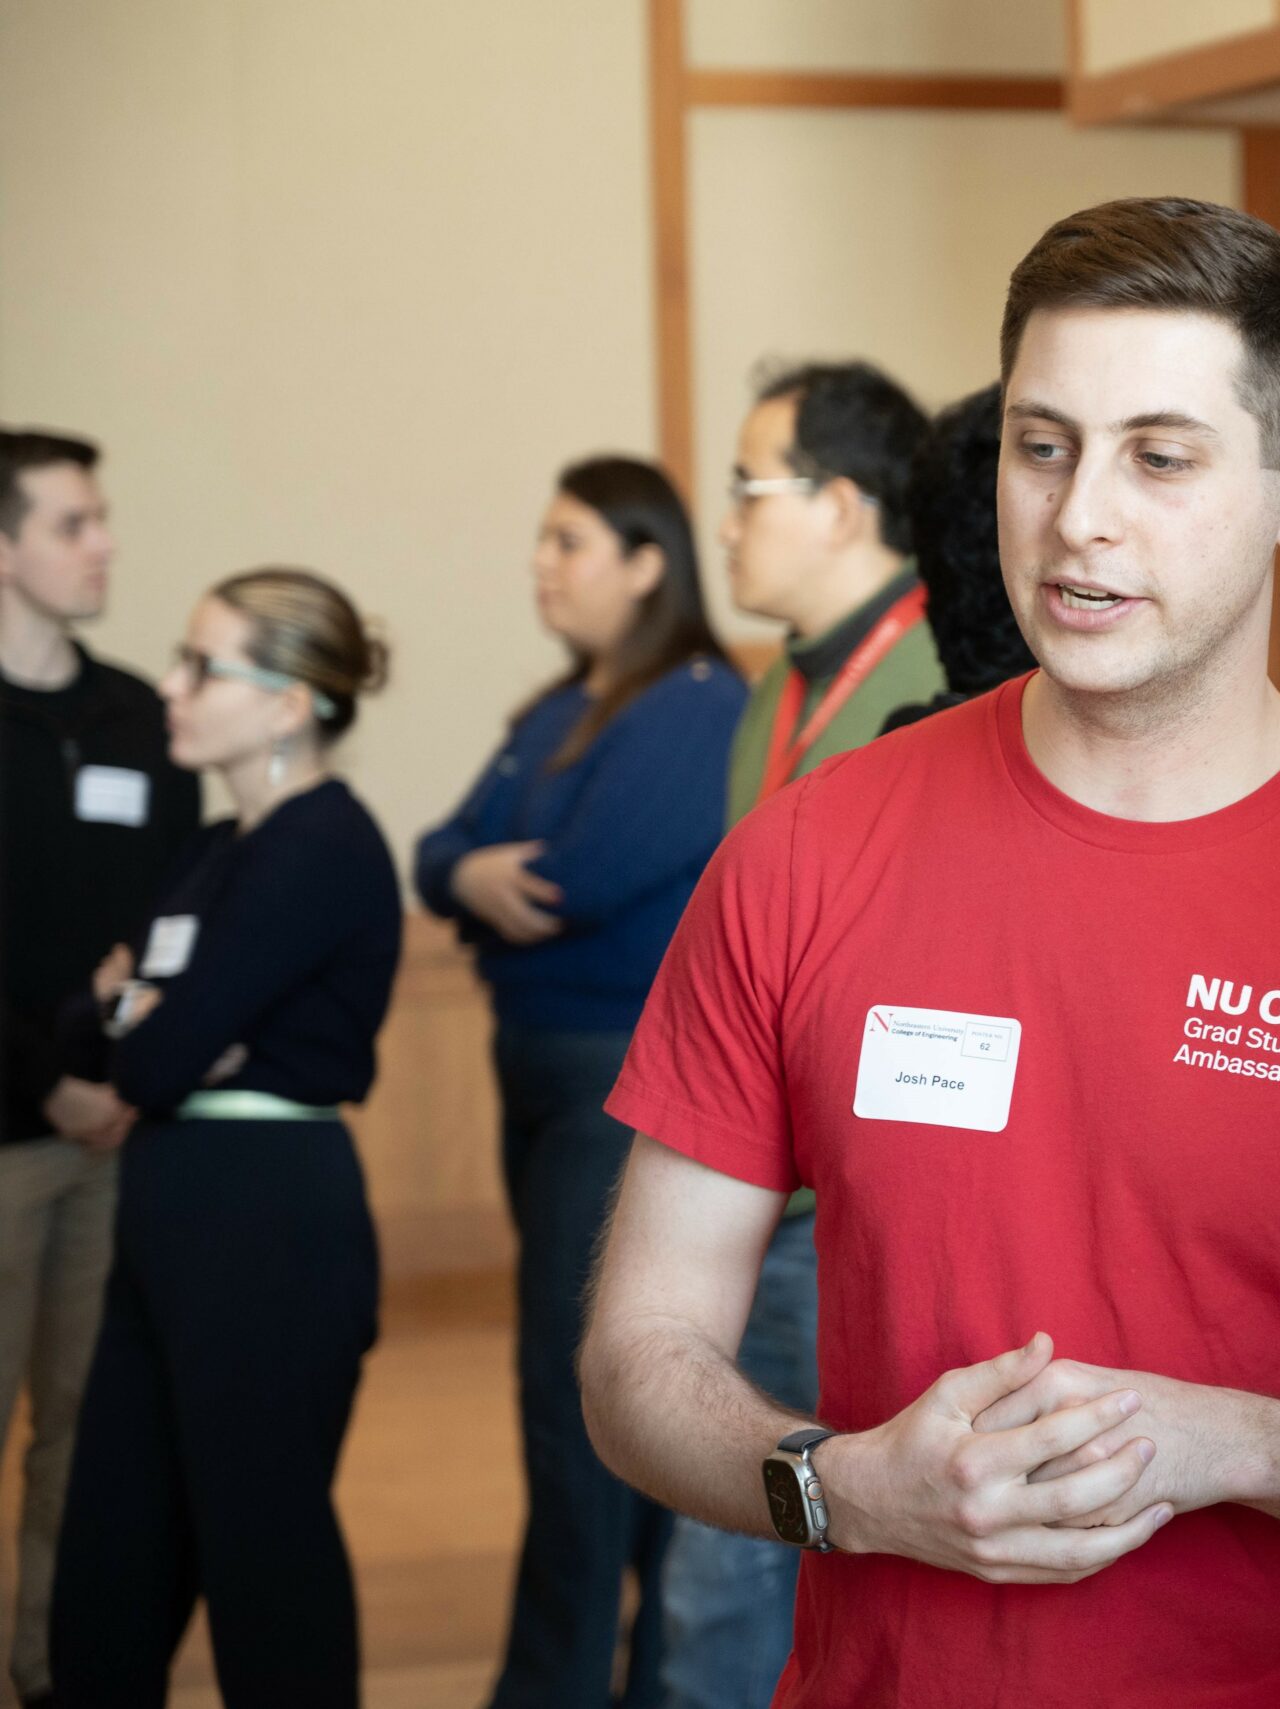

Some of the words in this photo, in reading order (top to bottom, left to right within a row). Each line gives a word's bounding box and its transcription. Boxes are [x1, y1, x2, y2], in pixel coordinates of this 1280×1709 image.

[1186, 974, 1253, 1015] NU
[891, 1028, 914, 1037] College
[922, 1031, 958, 1042] Engineering
[1183, 1017, 1242, 1045] Grad
[980, 1042, 991, 1051] 62
[895, 1071, 927, 1086] Josh
[931, 1075, 965, 1091] Pace
